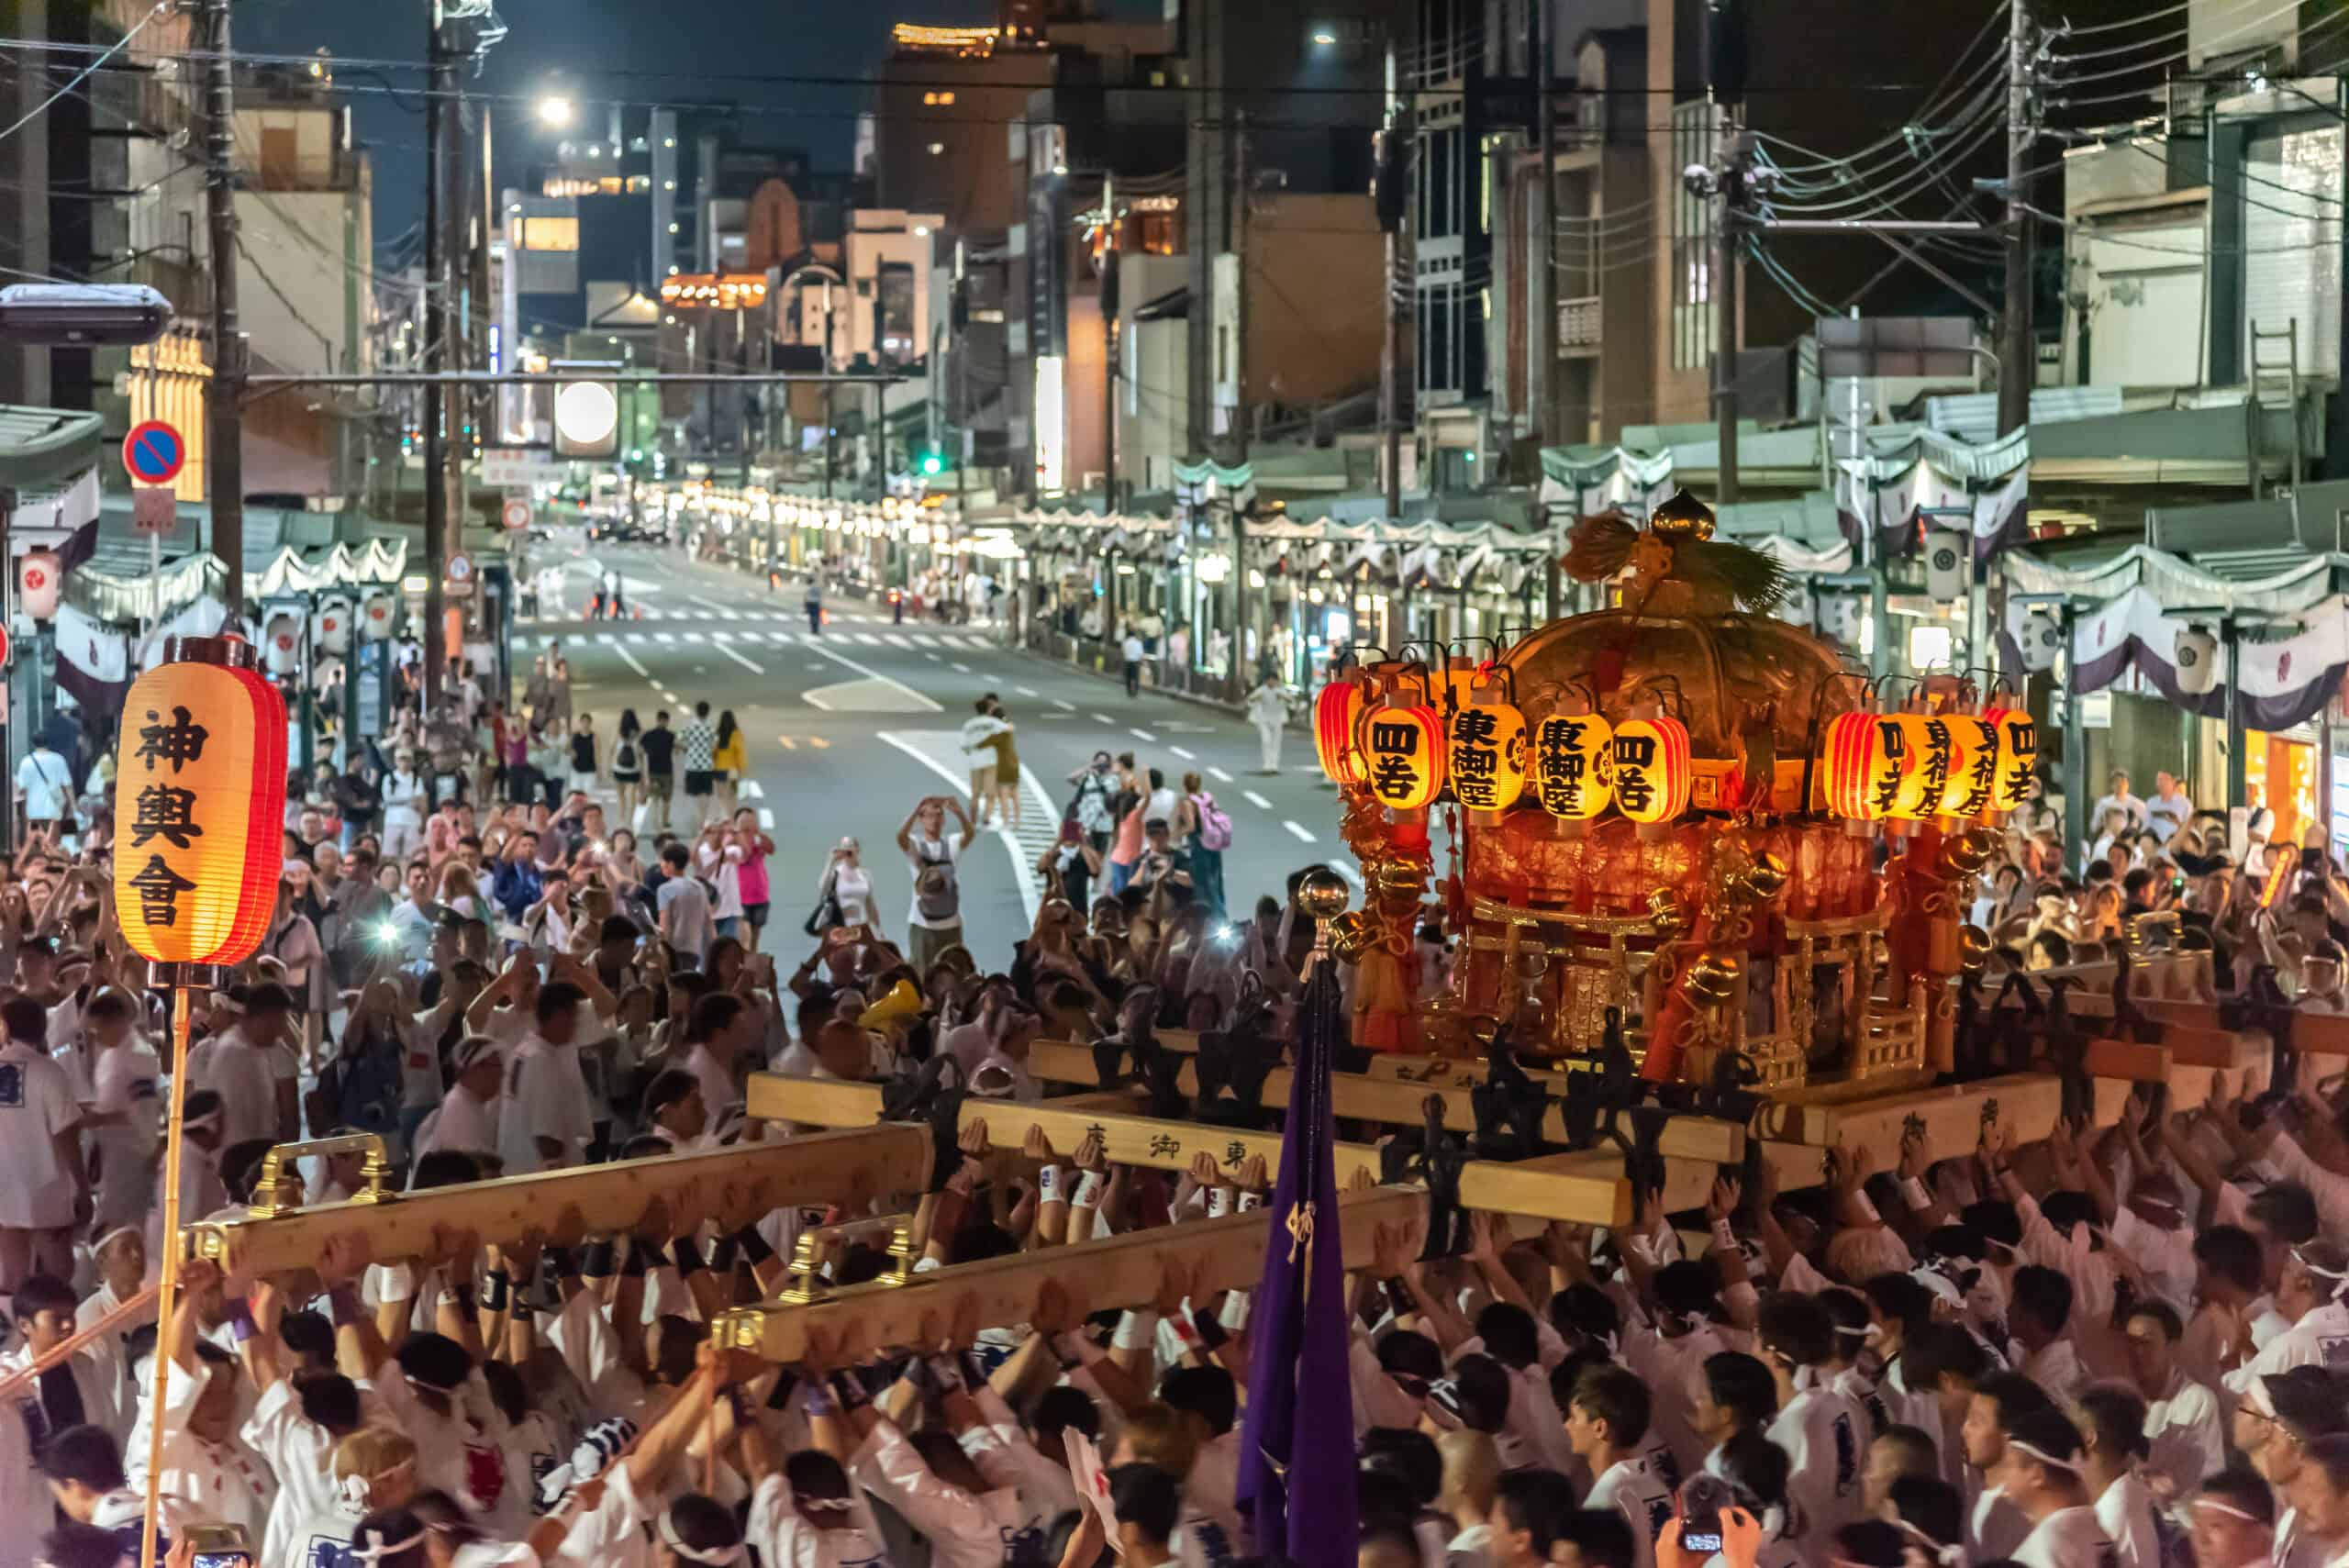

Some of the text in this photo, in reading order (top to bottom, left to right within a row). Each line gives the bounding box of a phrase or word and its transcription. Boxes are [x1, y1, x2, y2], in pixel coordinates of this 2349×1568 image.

[1452, 709, 1498, 806] 東御座
[1538, 719, 1587, 815] 東御座
